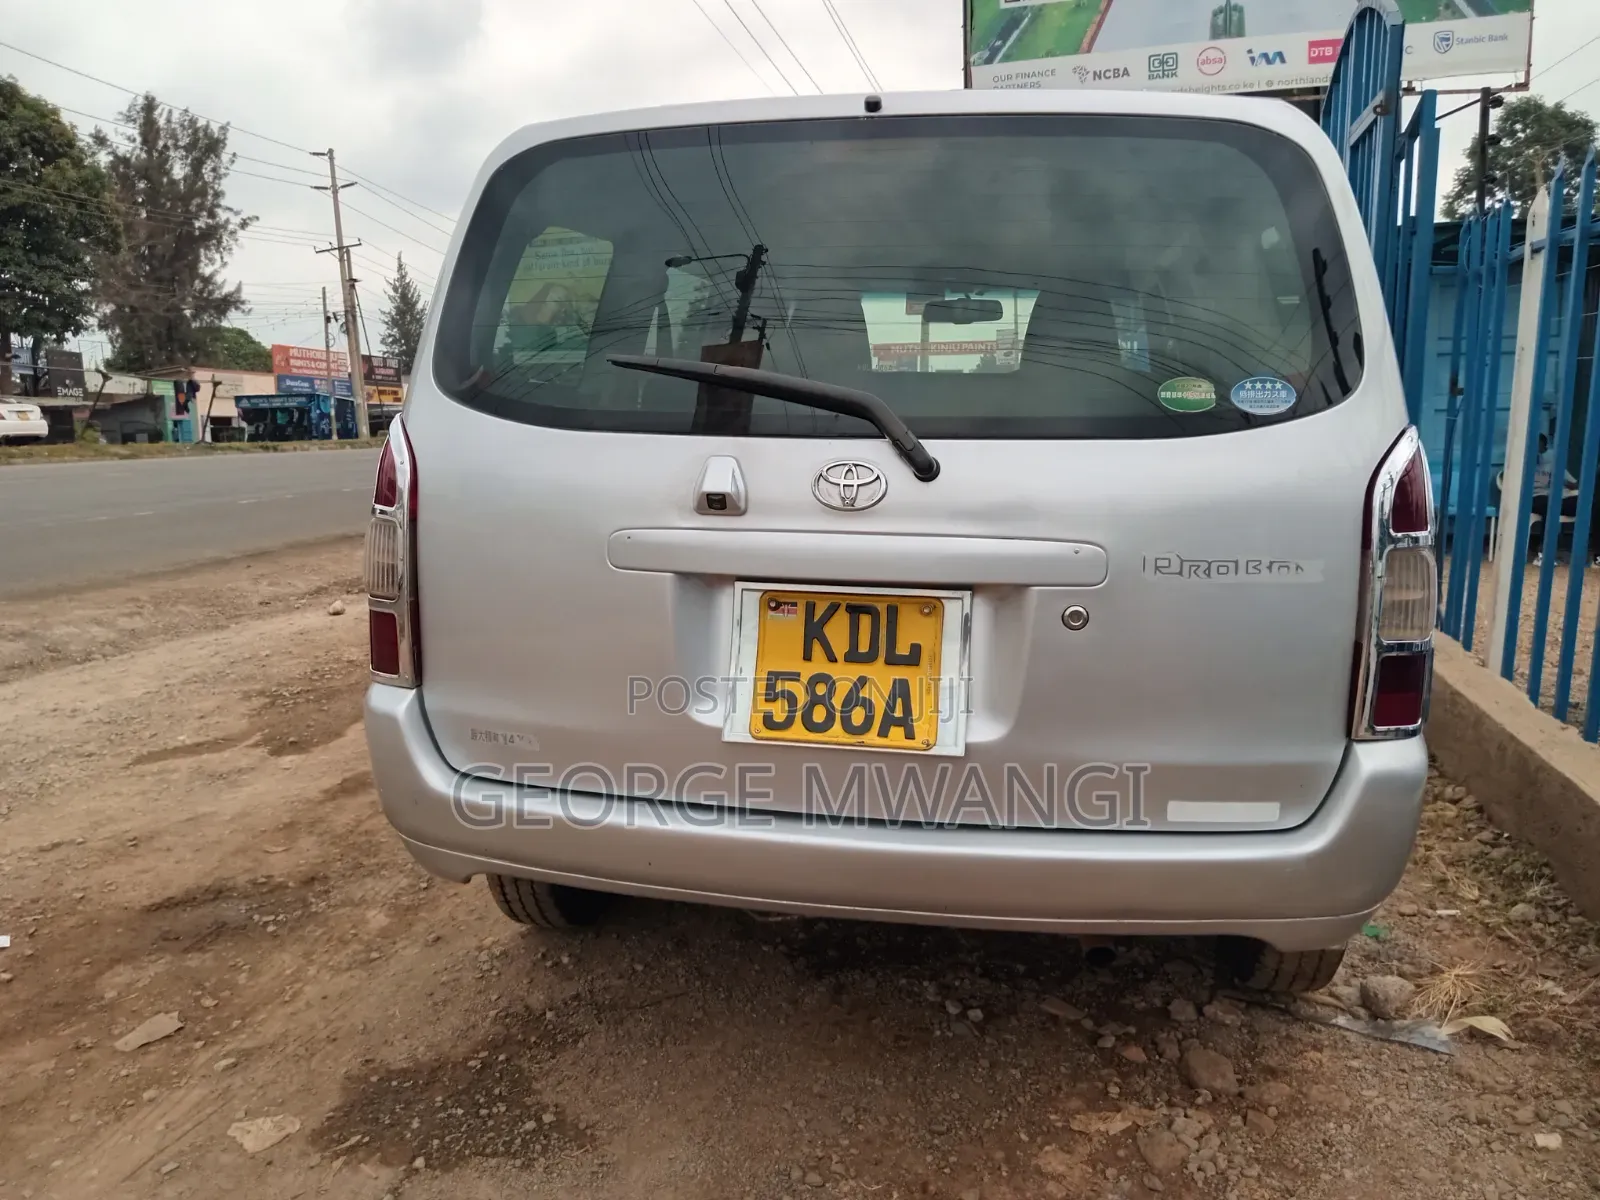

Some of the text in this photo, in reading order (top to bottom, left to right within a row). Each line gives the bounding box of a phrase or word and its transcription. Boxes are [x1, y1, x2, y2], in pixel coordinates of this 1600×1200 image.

[1455, 33, 1508, 46] Stanbic Bank
[1310, 46, 1334, 58] DTB
[1200, 55, 1224, 67] absa
[992, 68, 1057, 84] OUR FINANCE
[1092, 66, 1131, 82] NCBA
[1148, 71, 1179, 81] BANK
[890, 342, 962, 354] MUTHKINJU
[56, 386, 85, 398] EMAGE
[802, 600, 922, 667] KDL
[761, 670, 917, 740] 586A
